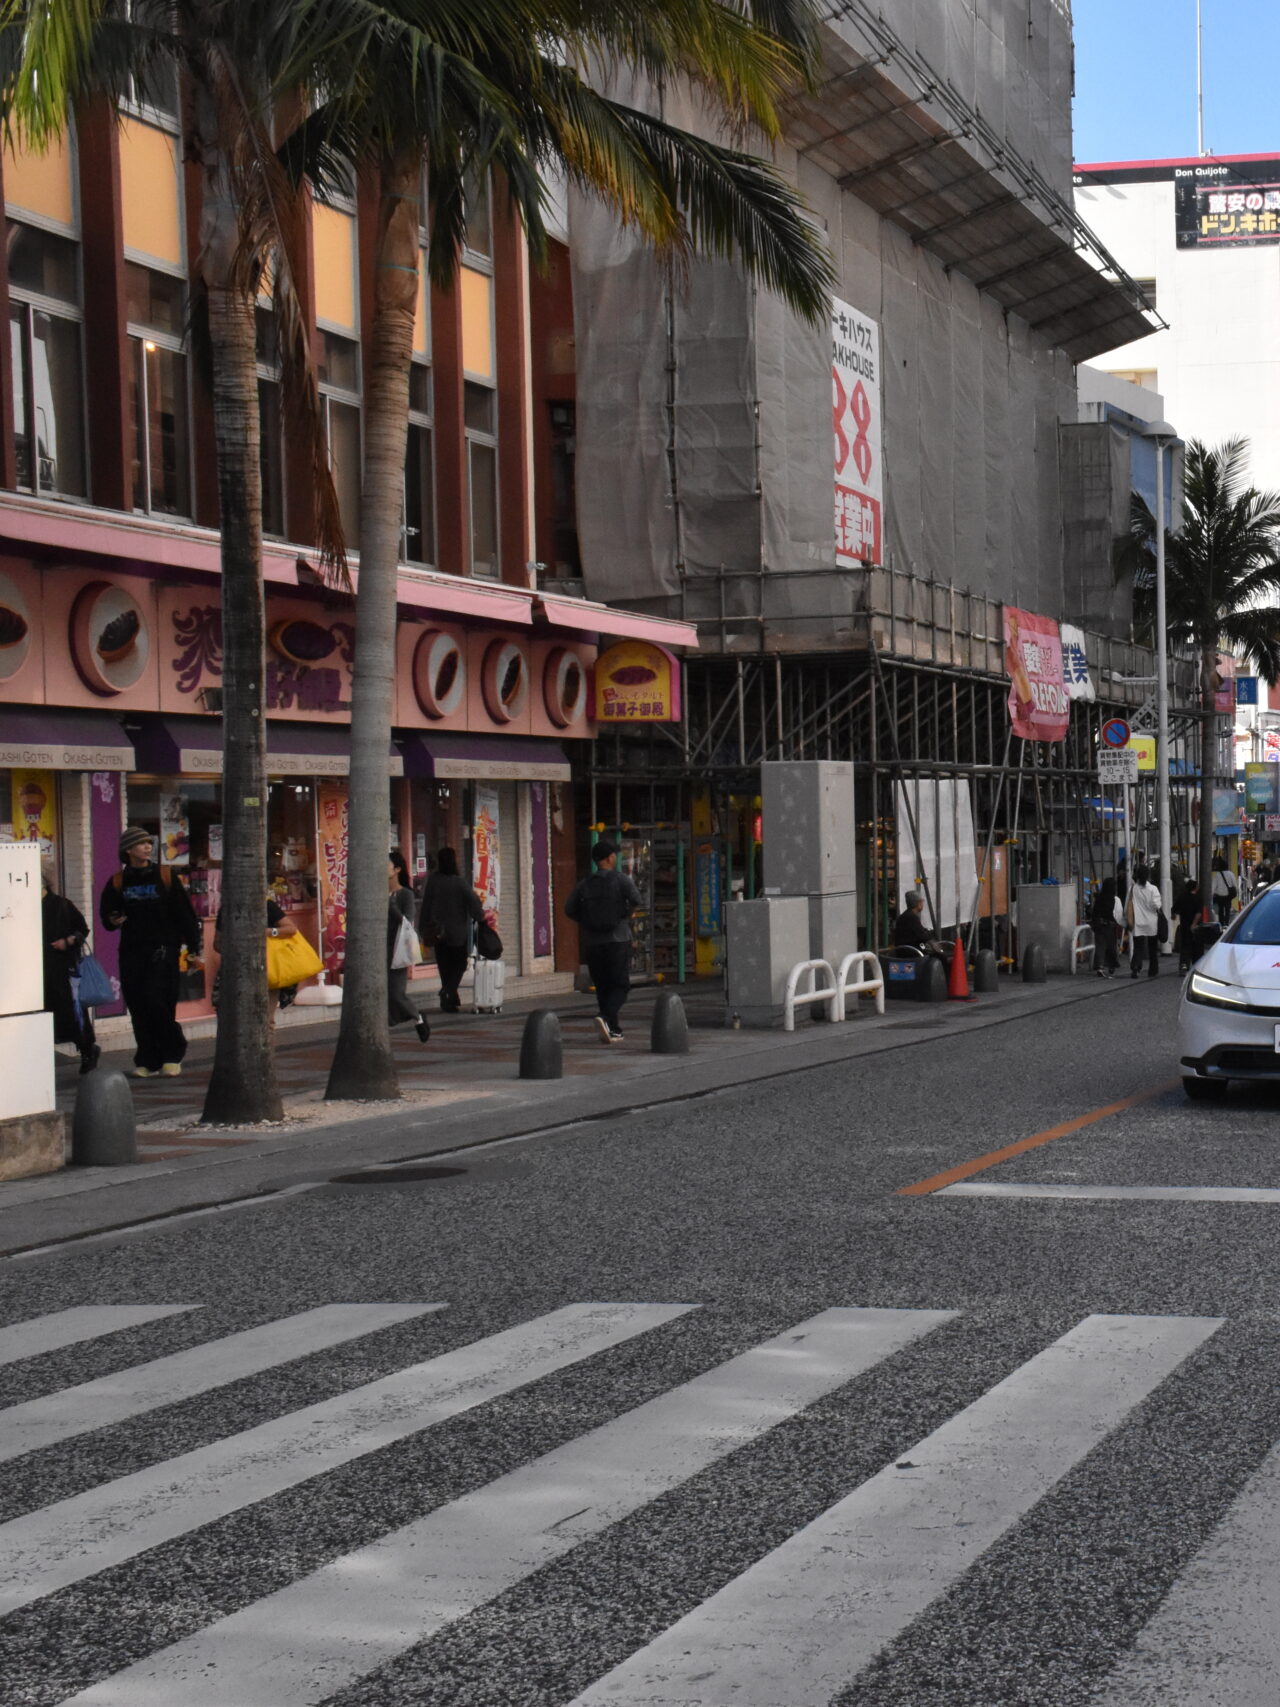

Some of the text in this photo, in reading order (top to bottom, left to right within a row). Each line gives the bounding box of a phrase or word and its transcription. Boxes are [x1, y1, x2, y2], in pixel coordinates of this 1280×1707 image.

[1175, 166, 1228, 178] Don Quijote
[1103, 774, 1134, 782] ここまで
